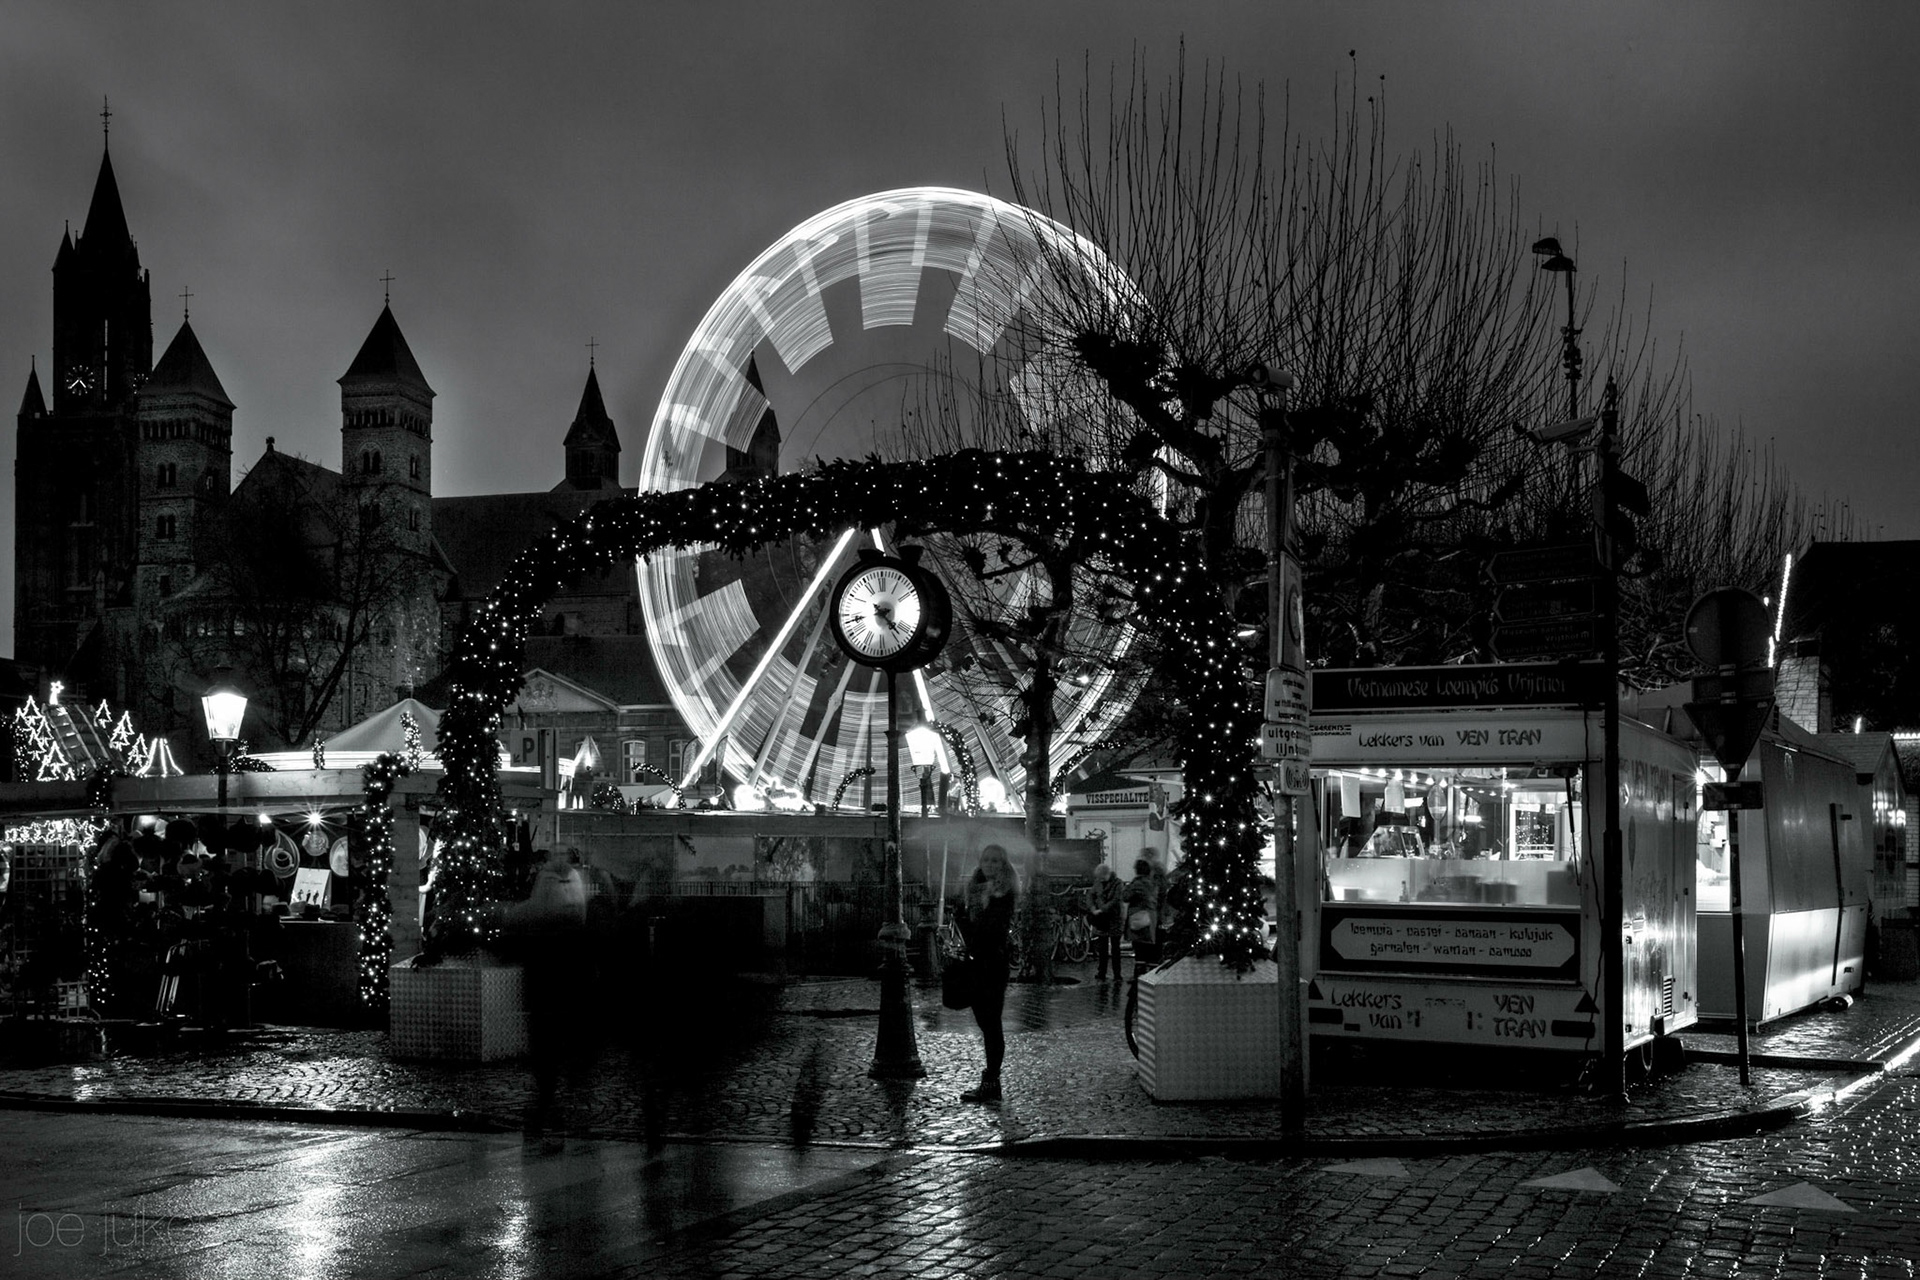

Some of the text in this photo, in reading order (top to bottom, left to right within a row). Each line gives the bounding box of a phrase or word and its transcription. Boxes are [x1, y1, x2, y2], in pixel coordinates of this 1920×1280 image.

[1347, 676, 1429, 698] Vietnamese
[1358, 729, 1542, 747] Lekkers van YEN TRAN
[522, 737, 535, 762] P
[1370, 941, 1420, 956] garnalen
[1331, 987, 1402, 1010] Lekkers
[1493, 994, 1535, 1014] YEN
[1369, 1013, 1402, 1029] van
[1493, 1017, 1546, 1038] TRAN
